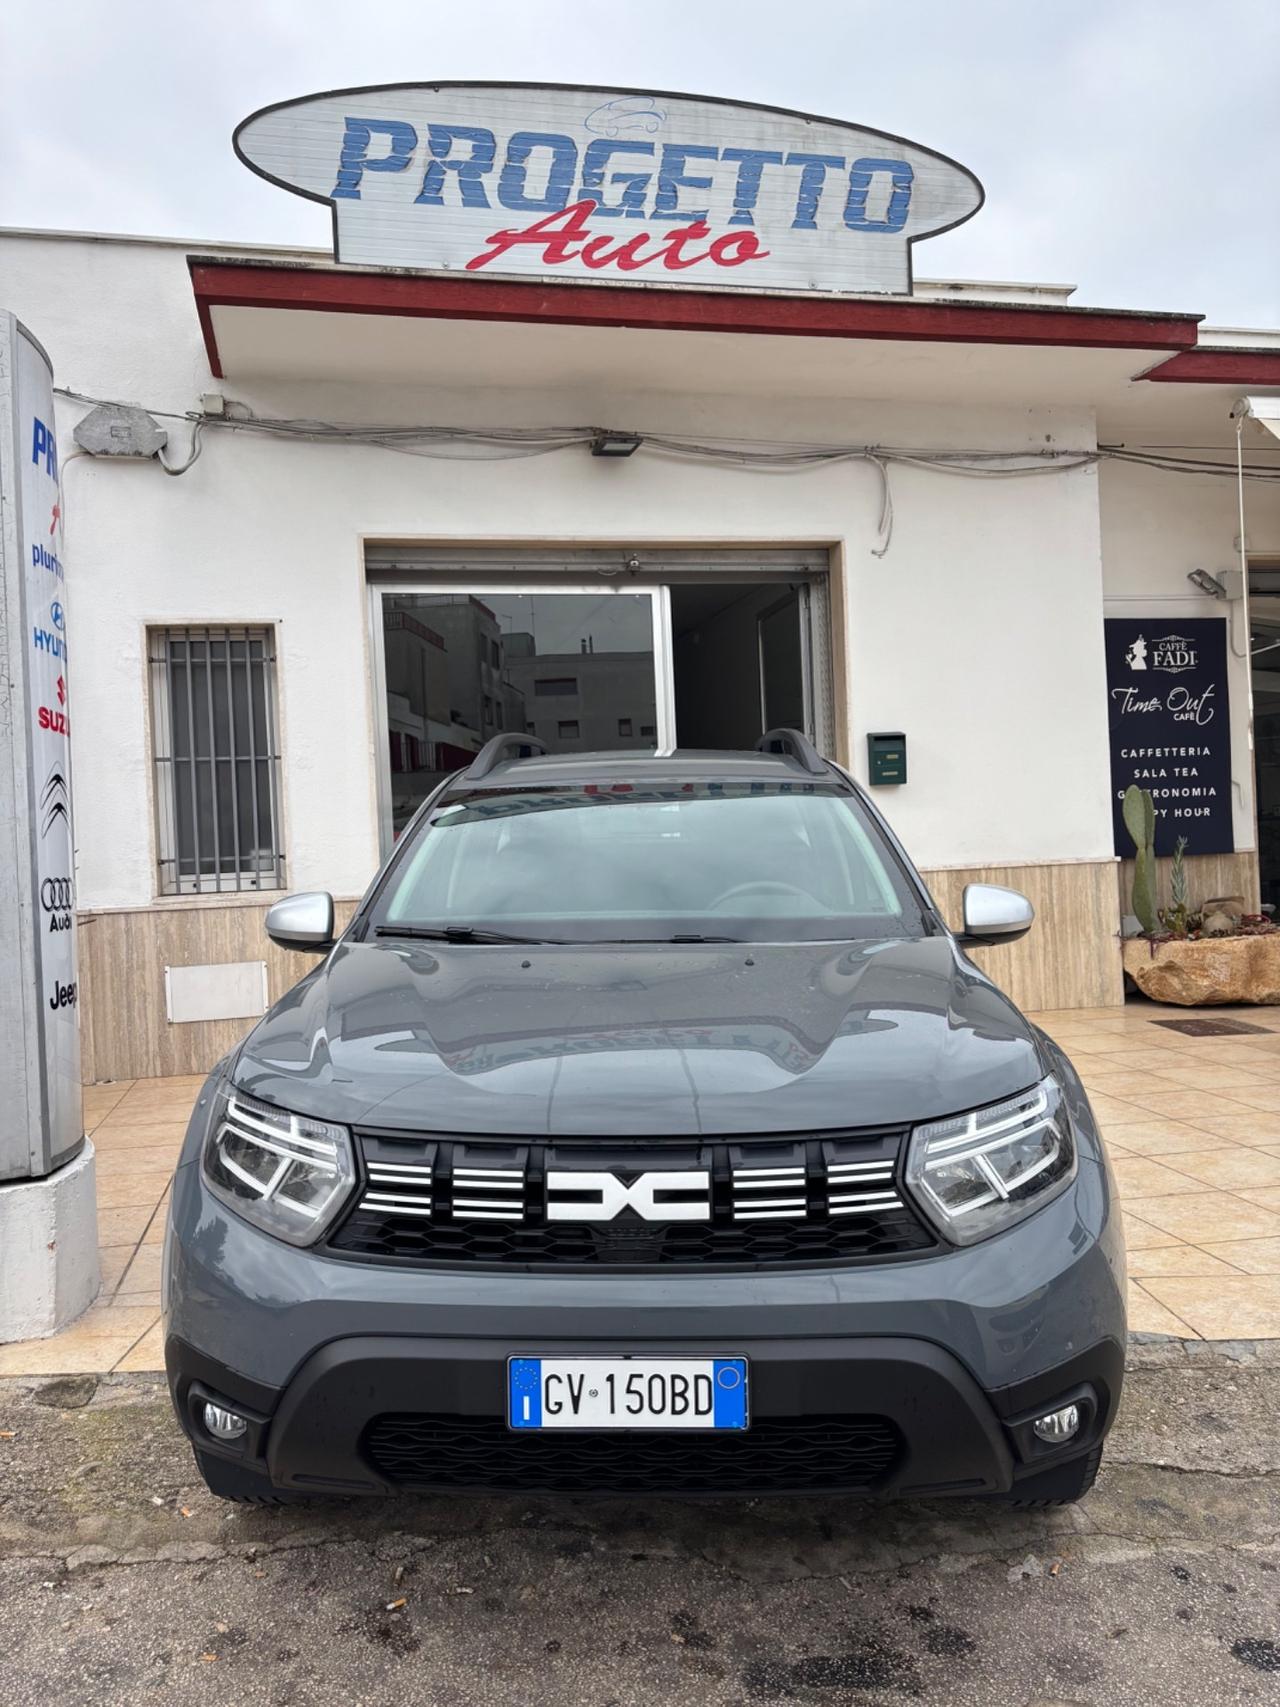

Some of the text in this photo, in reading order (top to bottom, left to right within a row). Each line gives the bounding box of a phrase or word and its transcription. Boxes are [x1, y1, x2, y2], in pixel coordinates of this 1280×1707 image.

[331, 117, 912, 232] PROGETTO
[465, 199, 770, 271] Auto
[32, 416, 60, 488] PR
[1152, 651, 1196, 666] FADI
[1111, 684, 1215, 726] Time Out
[1120, 746, 1211, 758] CAFFETTERIA
[1134, 767, 1199, 778] SALA TEA
[1117, 787, 1217, 800] GRONOMIA
[1174, 807, 1211, 818] HOUR
[49, 980, 78, 1010] Jeep
[544, 1373, 713, 1416] GV 150BD
